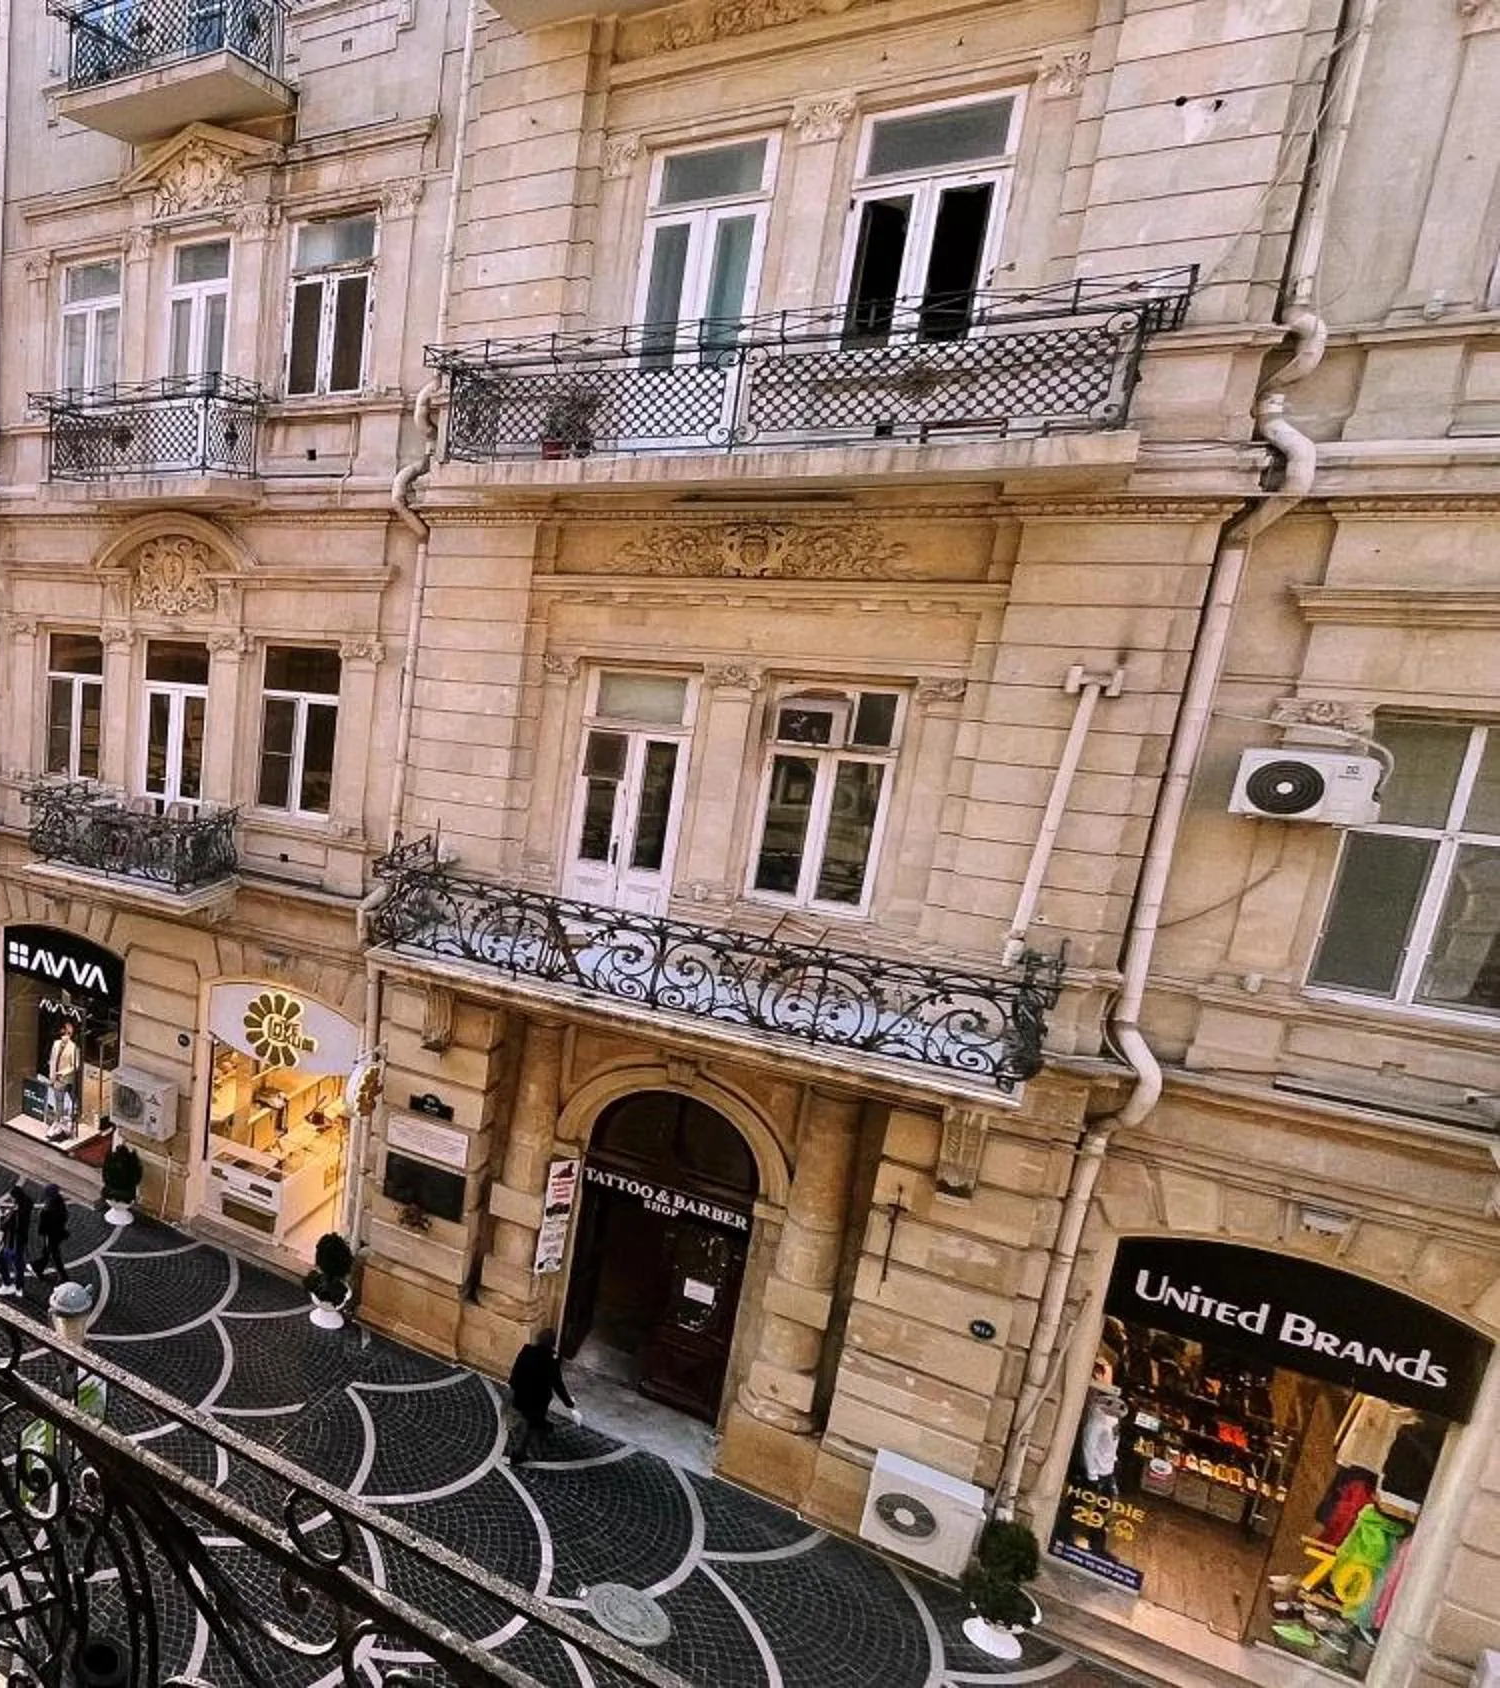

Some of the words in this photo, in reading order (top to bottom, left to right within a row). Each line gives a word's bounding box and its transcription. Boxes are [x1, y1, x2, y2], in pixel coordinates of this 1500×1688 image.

[30, 949, 109, 994] AVVA
[585, 1167, 653, 1199] TATTOO
[655, 1190, 671, 1204] &
[673, 1194, 748, 1231] BARBER
[643, 1199, 679, 1217] SHOP
[1067, 1484, 1146, 1523] HOODIE
